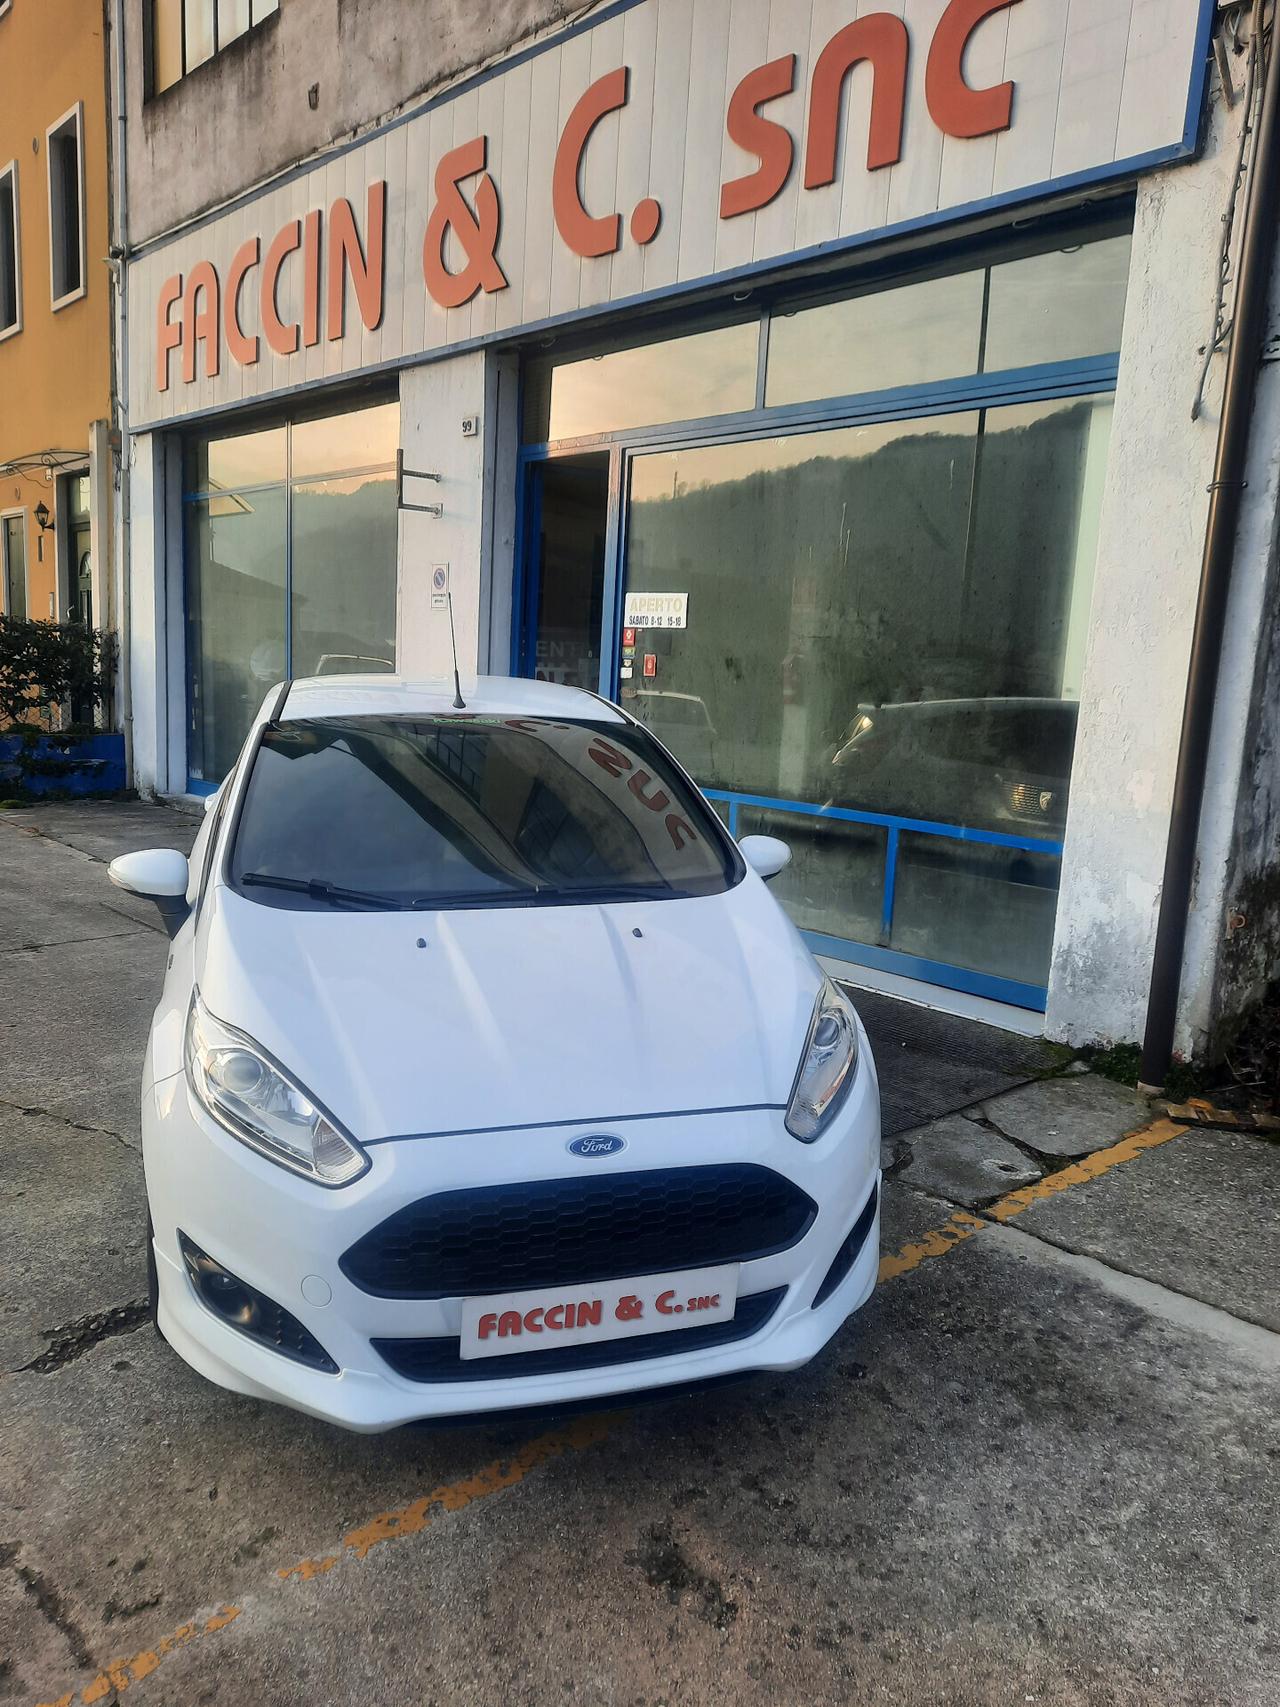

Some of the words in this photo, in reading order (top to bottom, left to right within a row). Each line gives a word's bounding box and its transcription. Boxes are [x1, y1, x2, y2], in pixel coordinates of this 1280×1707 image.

[157, 180, 387, 392] FACCIN
[423, 135, 508, 308] &
[552, 66, 662, 257] C.
[462, 420, 472, 433] 99
[630, 598, 682, 613] APERTO
[629, 615, 649, 625] SABATO
[581, 1138, 613, 1153] Ford
[478, 1300, 603, 1340] FACCIN
[615, 1295, 643, 1321] &
